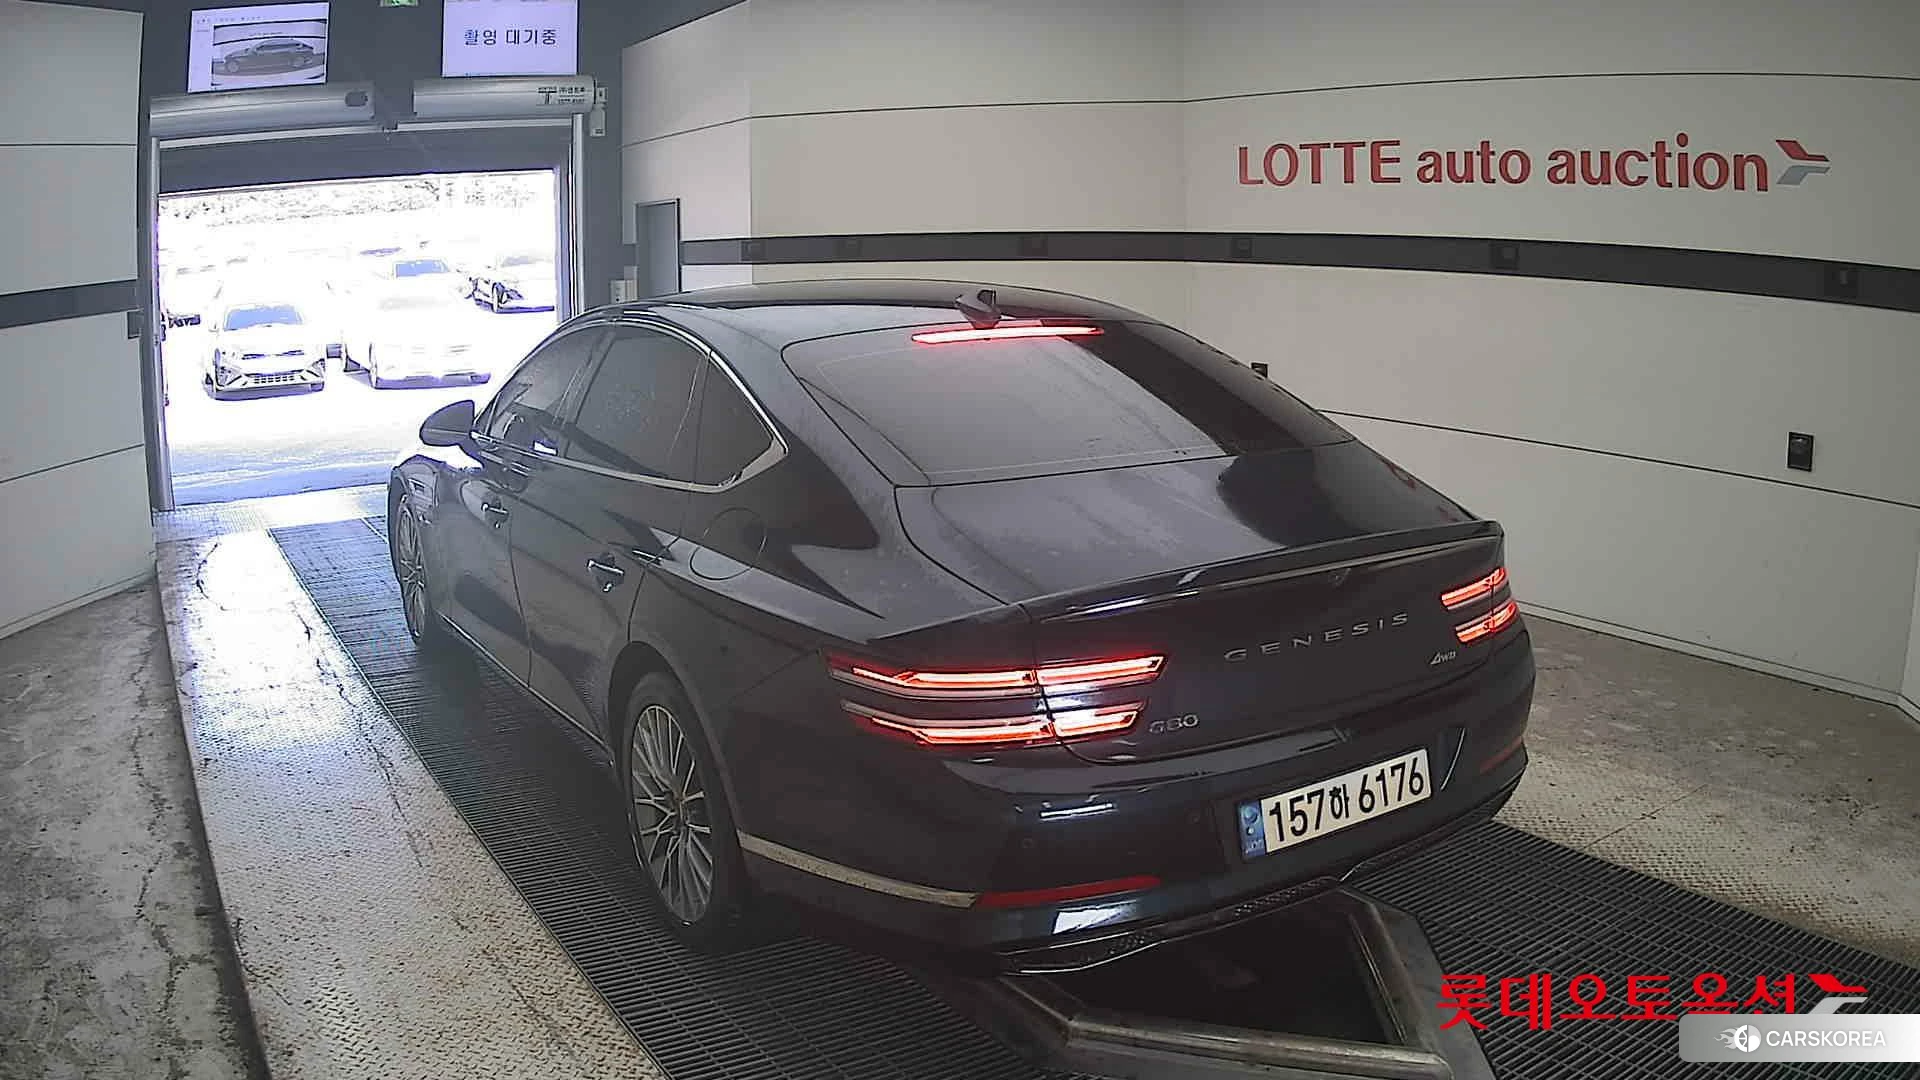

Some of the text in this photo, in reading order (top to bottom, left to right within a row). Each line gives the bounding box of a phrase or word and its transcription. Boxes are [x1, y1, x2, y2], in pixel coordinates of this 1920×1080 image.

[464, 29, 557, 46] 촬영 대기중
[1238, 132, 1769, 192] LOTTE auto auction
[1223, 612, 1408, 662] GENESIS
[1149, 714, 1199, 734] G80
[1269, 757, 1425, 843] 157하 6176
